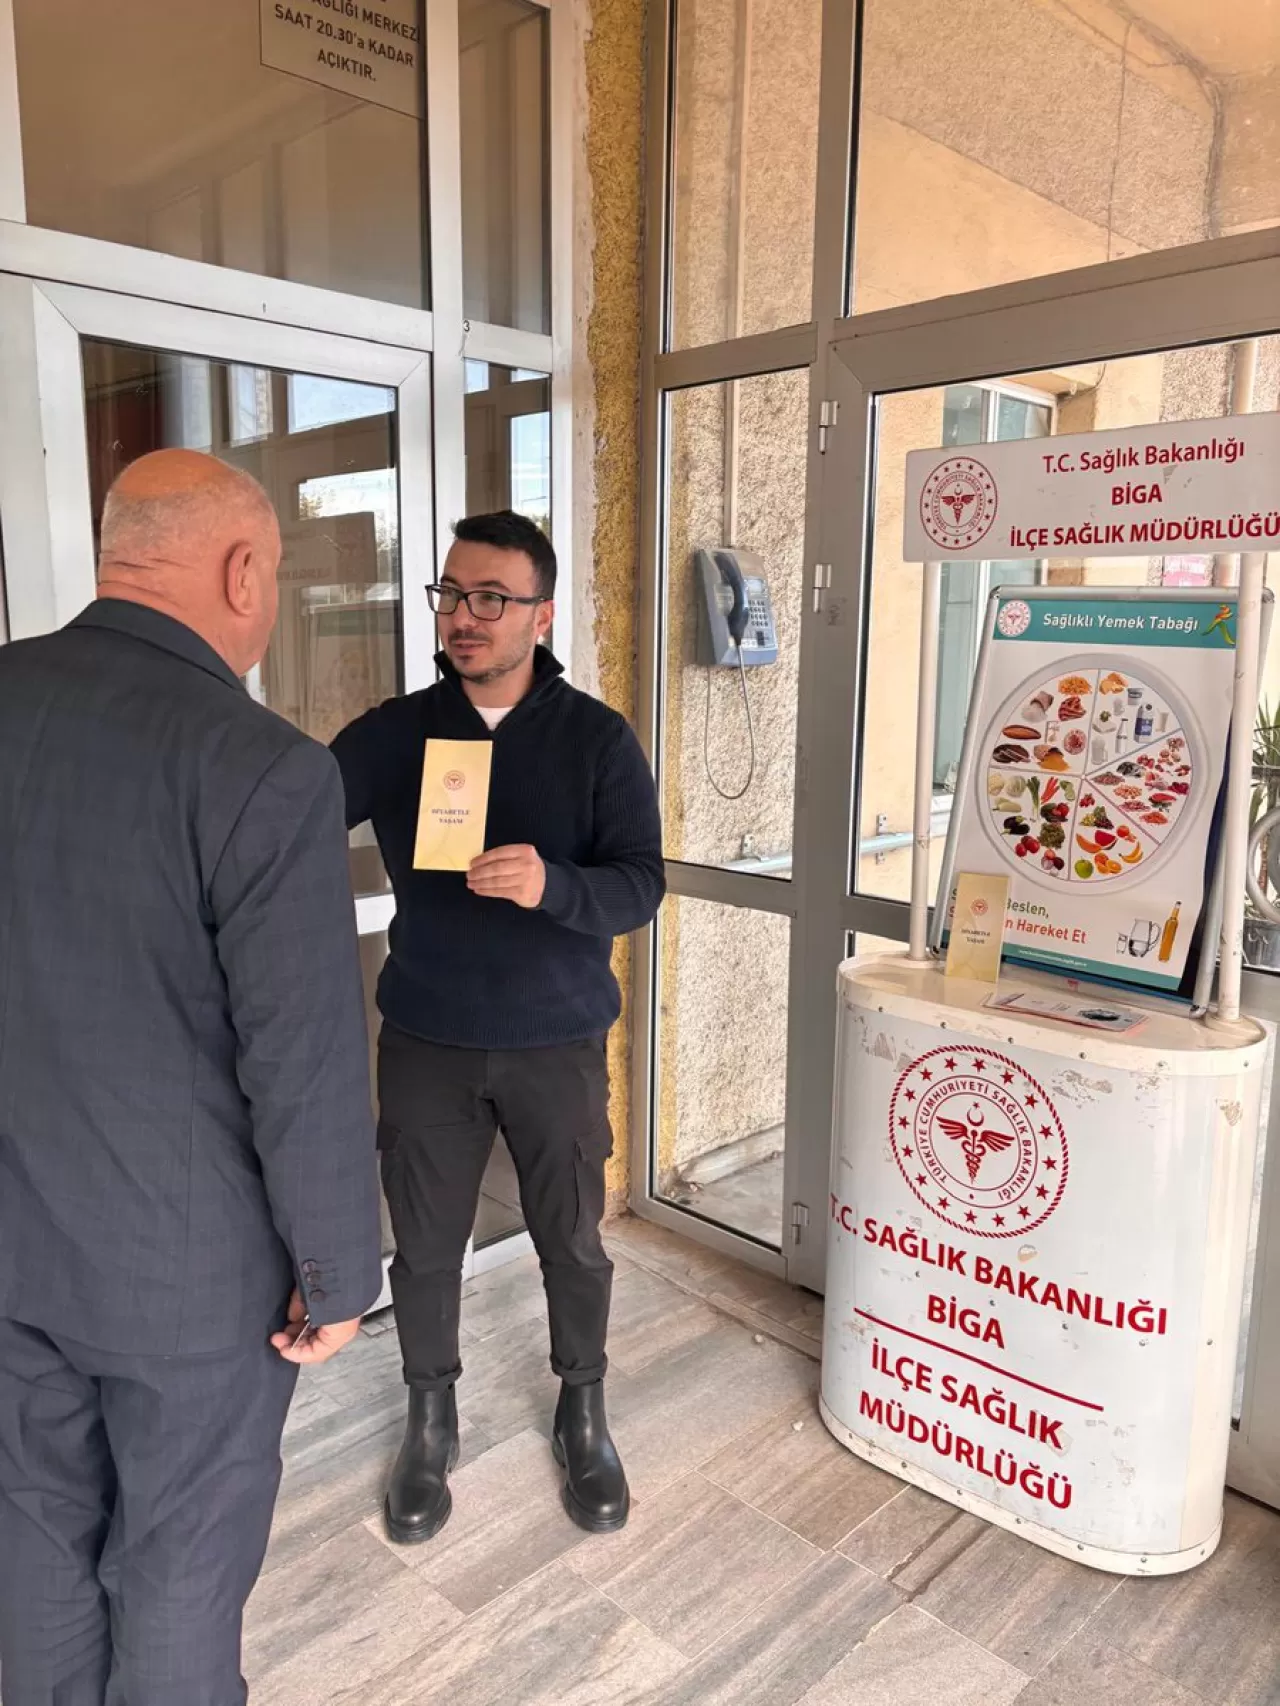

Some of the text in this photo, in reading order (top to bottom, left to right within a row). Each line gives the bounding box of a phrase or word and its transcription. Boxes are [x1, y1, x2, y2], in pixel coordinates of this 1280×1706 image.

[274, 4, 415, 68] SAAT 20.30'a KADAR
[316, 48, 377, 82] AÇIKTIR.
[463, 319, 470, 332] 3
[1043, 437, 1245, 474] T.C. Sağlık Bakanlığı
[1111, 481, 1163, 506] BİGA
[1010, 512, 1280, 551] İLÇE SAĞLIK MÜDÜRLÜĞÜ
[1043, 613, 1093, 630] Sağlıklı
[1097, 615, 1144, 630] Yemek
[1149, 616, 1198, 632] Tabağı
[1016, 917, 1069, 941] Hareket
[1072, 929, 1087, 944] Et
[920, 1080, 989, 1124] CUMHURİYETİ
[992, 1091, 1028, 1134] SAĞLIK
[998, 1139, 1033, 1201] BAKANLIĞI
[830, 1193, 1168, 1335] T.C. SAĞLIK BAKANLIĞI
[927, 1295, 1005, 1348] BİGA
[871, 1338, 1064, 1450] İLÇE SAĞLIK
[859, 1390, 1073, 1510] MÜDÜRLÜĞÜ
